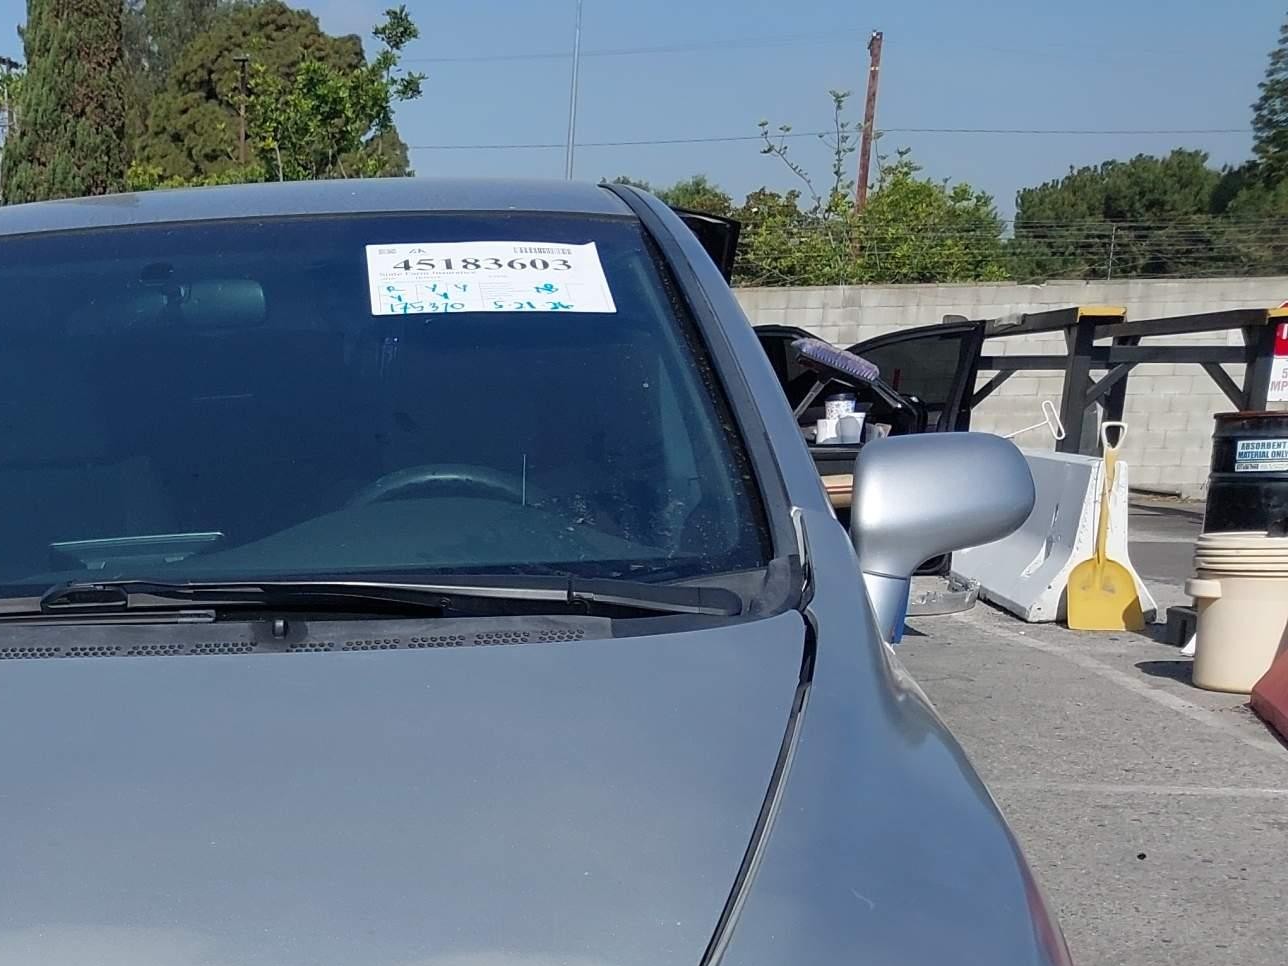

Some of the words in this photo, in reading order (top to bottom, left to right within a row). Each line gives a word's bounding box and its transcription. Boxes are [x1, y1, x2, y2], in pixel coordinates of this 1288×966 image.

[392, 257, 573, 272] 45183603
[1240, 441, 1287, 450] ABSORBENT
[1238, 450, 1269, 459] MATERIAL
